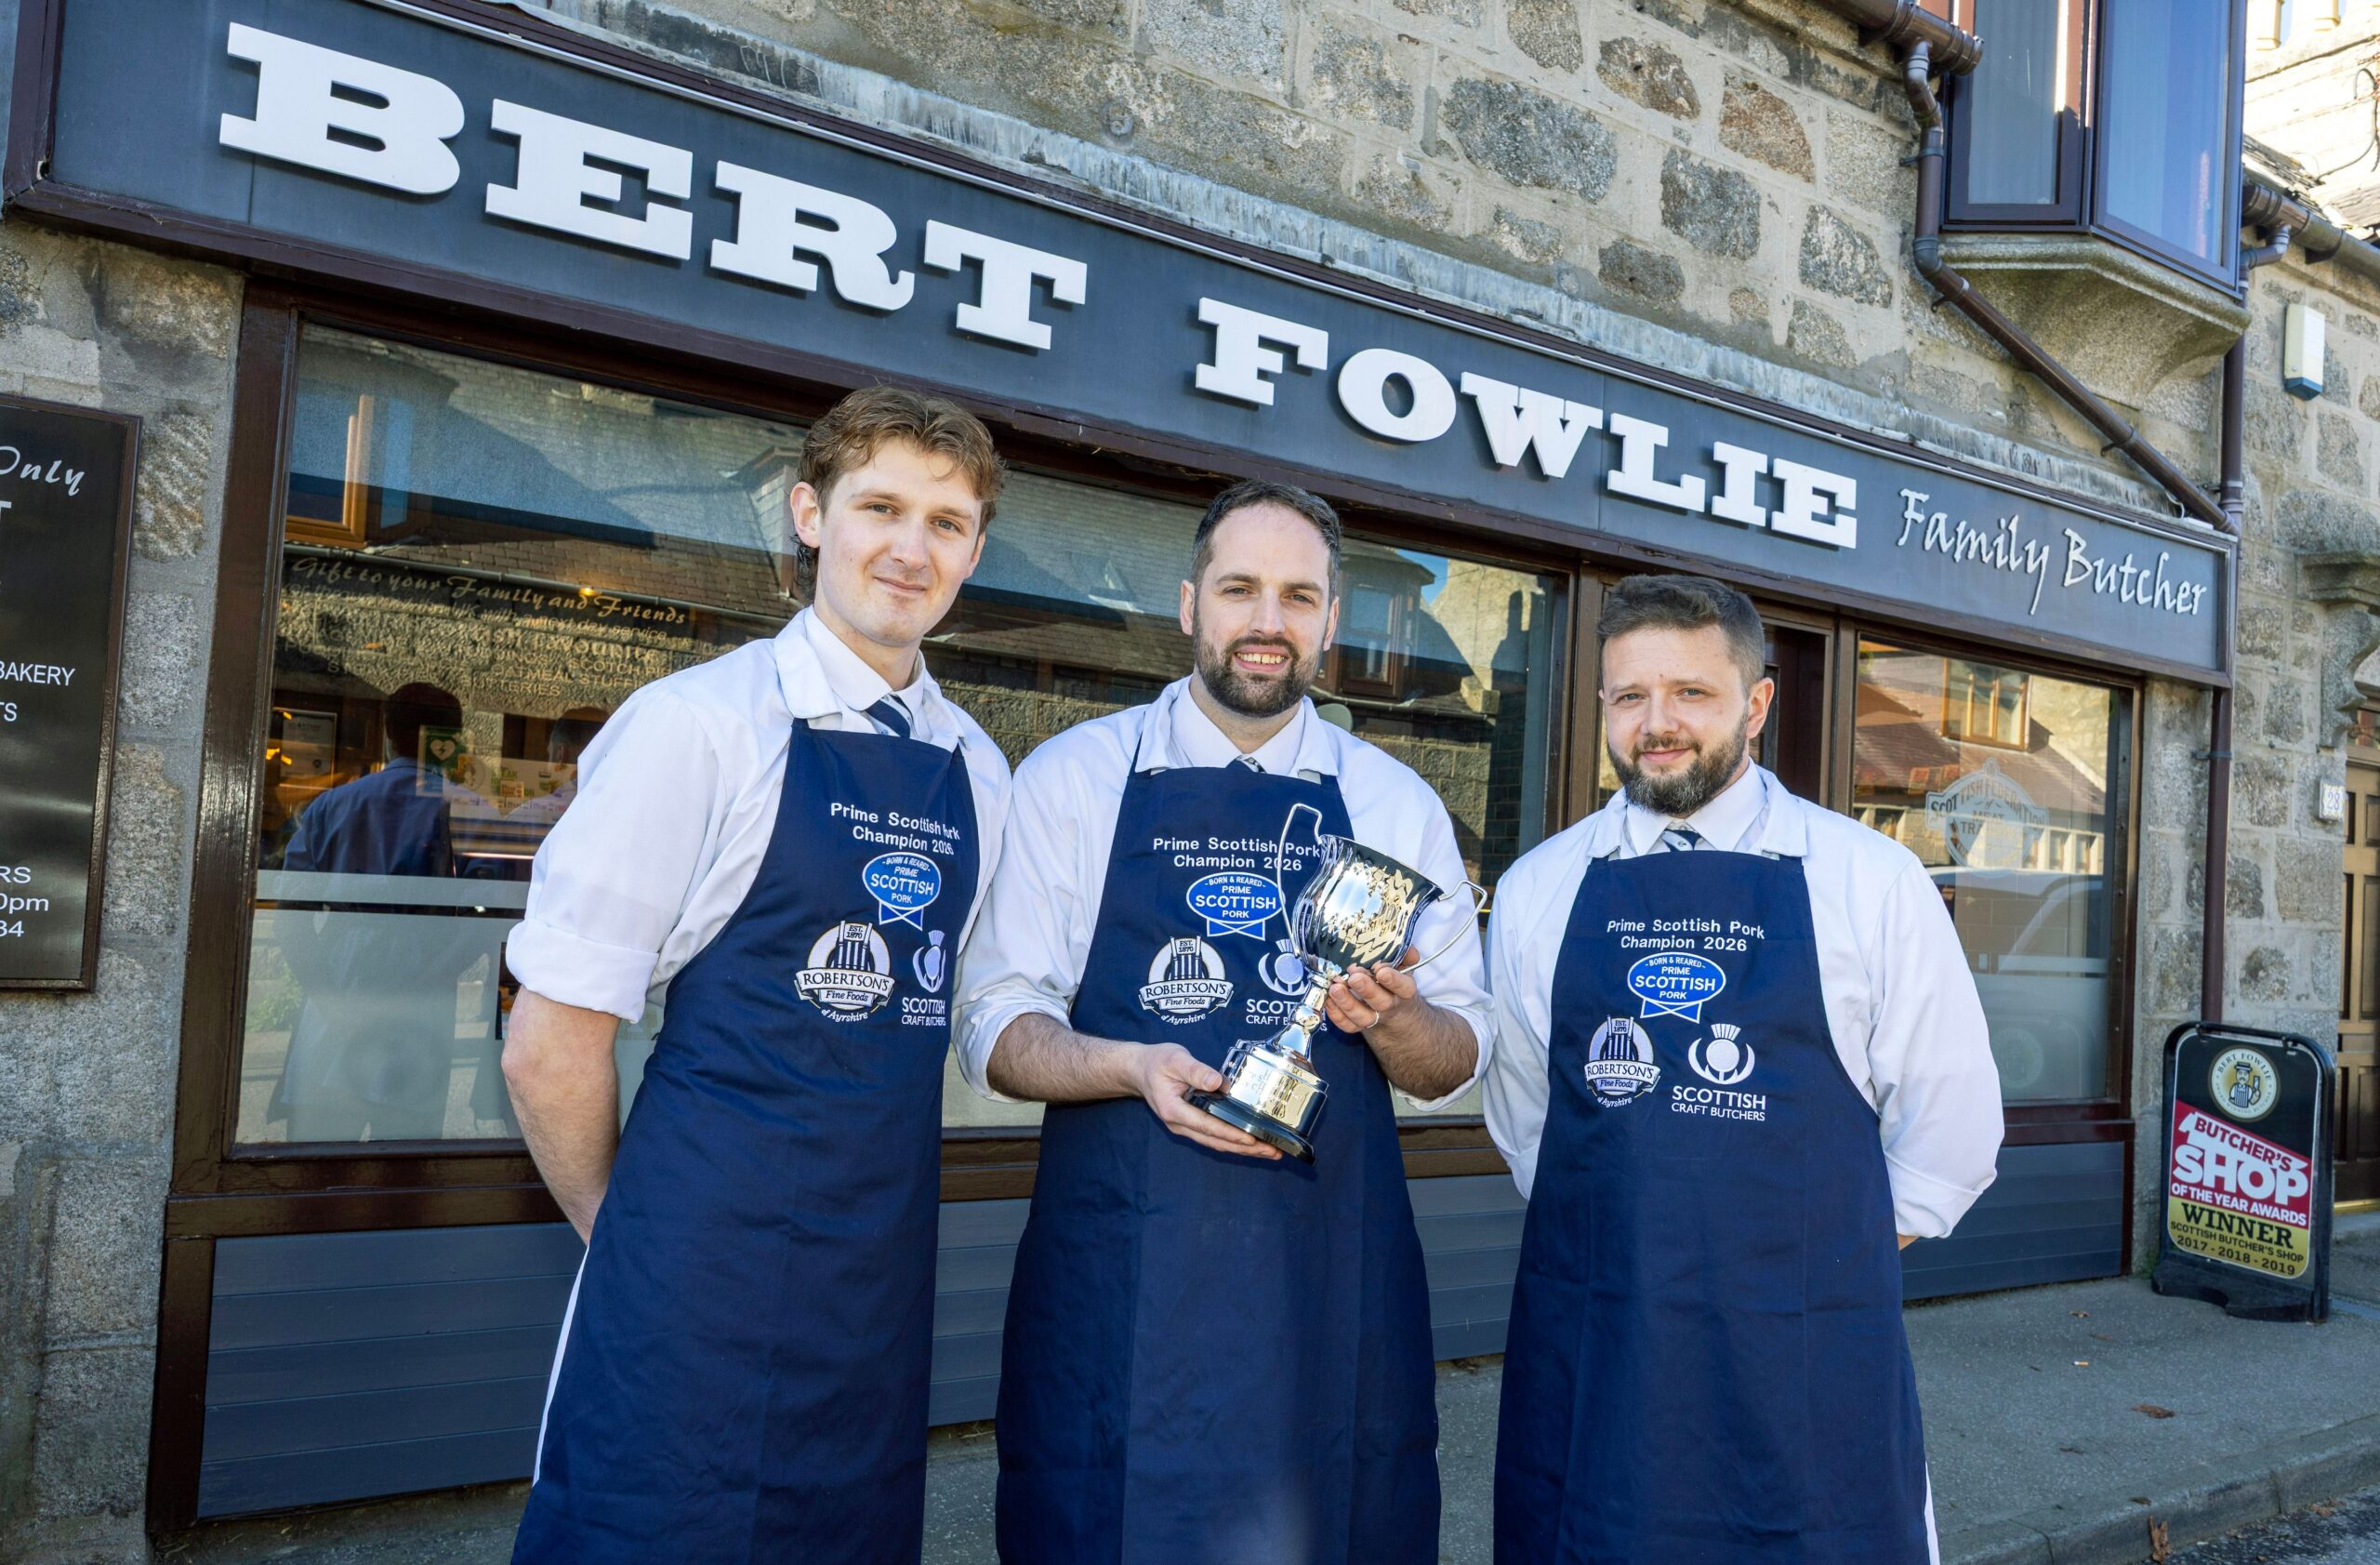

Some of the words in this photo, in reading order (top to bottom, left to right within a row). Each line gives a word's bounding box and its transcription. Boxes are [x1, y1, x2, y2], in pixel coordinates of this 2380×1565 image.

[218, 22, 1088, 351] BERT
[1196, 297, 1858, 550] FOWLIE
[1897, 488, 2049, 616] Family
[2063, 527, 2207, 616] Butcher
[292, 557, 352, 584] Gift
[358, 568, 382, 583] to
[389, 575, 441, 592] your
[446, 575, 545, 611] Family
[548, 593, 588, 610] and
[594, 595, 686, 626] Friends
[491, 664, 574, 684] OATMEAL
[567, 657, 641, 676] SCOTCH
[2327, 791, 2340, 810] 28
[830, 802, 879, 823] Prime
[888, 812, 941, 834] Scottish
[853, 826, 928, 850] Champion
[1153, 838, 1199, 850] Prime
[1208, 837, 1278, 854] Scottish
[1285, 842, 1321, 857] Pork
[886, 856, 903, 866] BORN
[1174, 854, 1256, 869] Champion
[894, 867, 919, 878] PRIME
[870, 873, 935, 896] SCOTTISH
[1209, 876, 1228, 886] BORN
[1236, 876, 1263, 887] REARED
[1222, 885, 1251, 895] PRIME
[892, 893, 912, 904] PORK
[1195, 895, 1277, 909] SCOTTISH
[1222, 909, 1250, 919] PORK
[1606, 919, 1646, 933] Prime
[1652, 918, 1721, 933] Scottish
[1729, 921, 1765, 940] Pork
[1620, 935, 1695, 950] Champion
[1703, 936, 1747, 952] 2026
[1649, 957, 1668, 966] BORN
[1675, 957, 1702, 968] REARED
[1661, 966, 1691, 975] PRIME
[803, 973, 890, 992] ROBERTSON'S
[1145, 982, 1227, 999] ROBERTSON'S
[1634, 975, 1716, 991] SCOTTISH
[826, 990, 845, 1001] Fine
[846, 991, 868, 1002] Foods
[1165, 998, 1183, 1007] Fine
[1183, 997, 1205, 1006] Foods
[1659, 990, 1687, 1000] PORK
[902, 997, 945, 1015] SCOTTISH
[1246, 999, 1326, 1021] SCOT
[827, 1010, 868, 1022] Ayrshire
[901, 1015, 925, 1027] CRAFT
[1167, 1014, 1206, 1025] Ayrshire
[1246, 1015, 1280, 1026] CRAFT
[1586, 1064, 1654, 1079] ROBERTSON'S
[1615, 1080, 1633, 1089] Foods
[1601, 1096, 1633, 1107] Ayrshire
[1673, 1085, 1766, 1110] SCOTTISH
[1671, 1103, 1709, 1115] CRAFT
[1711, 1107, 1765, 1121] BUTCHERS
[2194, 1117, 2294, 1173] BUTCHER'S
[2173, 1143, 2309, 1206] SHOP
[2171, 1183, 2188, 1196] OF
[2189, 1187, 2213, 1201] THE
[2215, 1192, 2248, 1213] YEAR
[2250, 1202, 2307, 1227] AWARDS
[2181, 1201, 2294, 1249] WINNER
[2171, 1221, 2216, 1240] SCOTTISH
[2218, 1231, 2274, 1255] BUTCHER'S
[2276, 1249, 2304, 1263] SHOP
[2177, 1234, 2208, 1252] 2017
[2218, 1246, 2251, 1264] 2018
[2262, 1257, 2295, 1276] 2019
